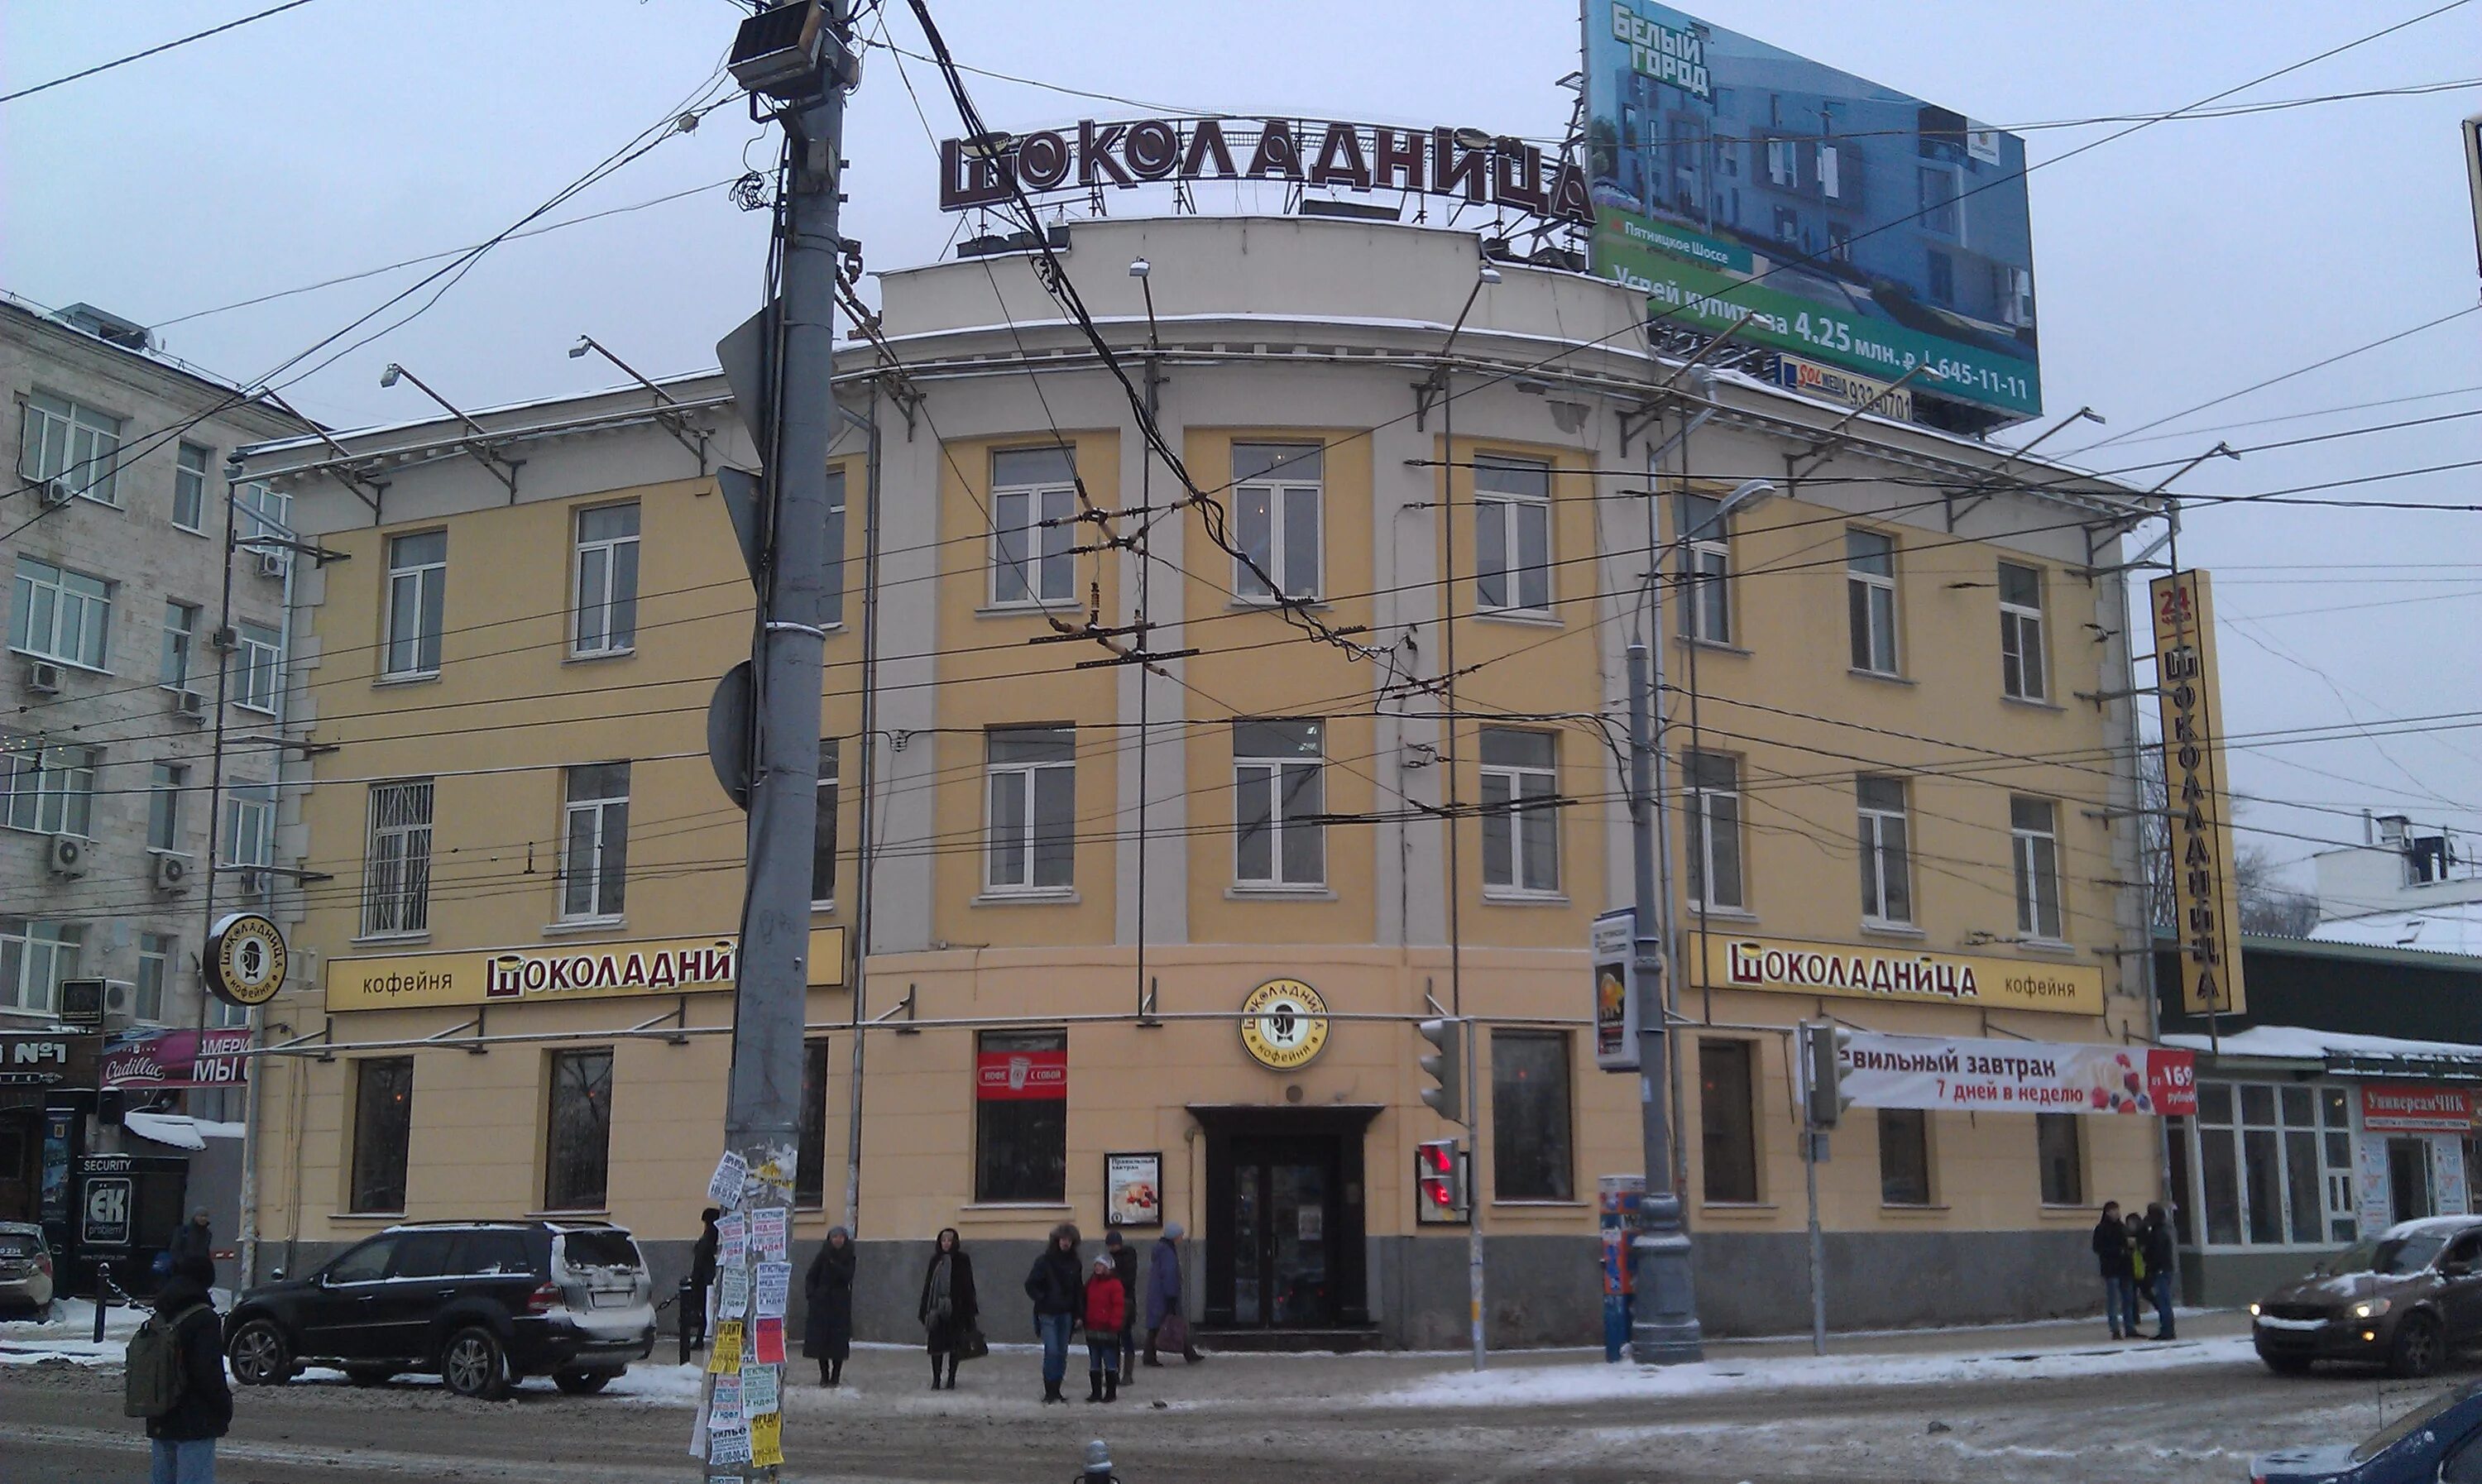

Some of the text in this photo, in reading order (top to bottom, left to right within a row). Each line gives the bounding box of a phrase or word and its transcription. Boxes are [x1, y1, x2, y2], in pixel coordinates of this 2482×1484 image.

[1612, 2, 1701, 65] БЕЛЫЙ
[1632, 42, 1709, 98] ГОРОД
[940, 122, 1597, 226] ШОКОЛАДНИЦА
[1625, 221, 1728, 264] Пятницкое Шоссе
[1613, 264, 1679, 305] Успей
[1794, 311, 1852, 352] 4.25
[1856, 338, 1900, 366] млн.
[1938, 357, 2027, 400] 645-11-11
[2160, 587, 2191, 615] 24
[362, 941, 733, 998] кофейня ШОКОЛАДНИ
[1730, 942, 2077, 998] ШОКОЛАДНИЦА кофейня
[107, 1056, 165, 1081] Cadillac
[192, 1056, 238, 1082] МЫ
[1966, 1056, 2056, 1082] завтрак
[2163, 1065, 2192, 1087] 169
[1937, 1079, 2083, 1106] 7 дней в неделю
[84, 1160, 132, 1171] SECURITY
